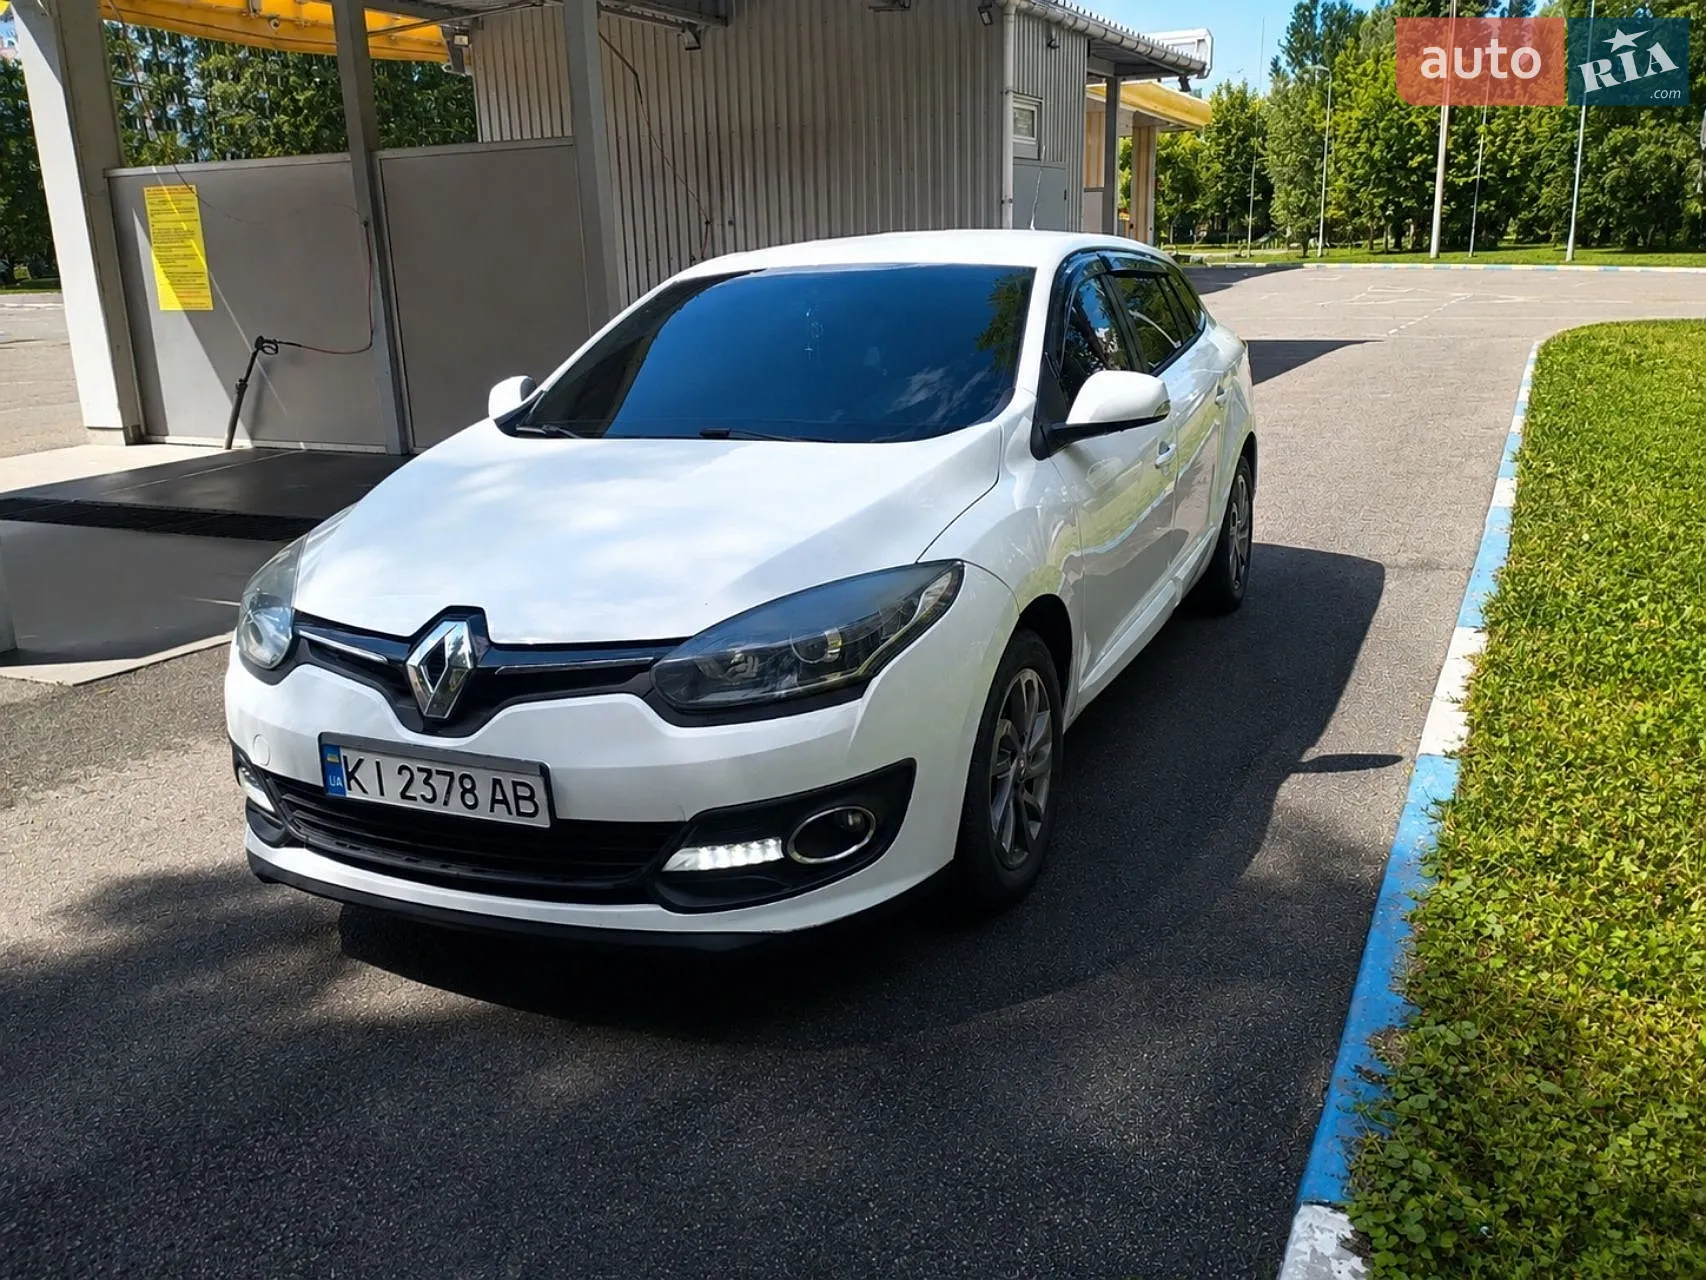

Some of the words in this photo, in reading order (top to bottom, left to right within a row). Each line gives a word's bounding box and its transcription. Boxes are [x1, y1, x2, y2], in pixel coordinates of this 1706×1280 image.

[329, 775, 343, 787] UA
[397, 764, 479, 811] 2378
[489, 777, 540, 819] AB
